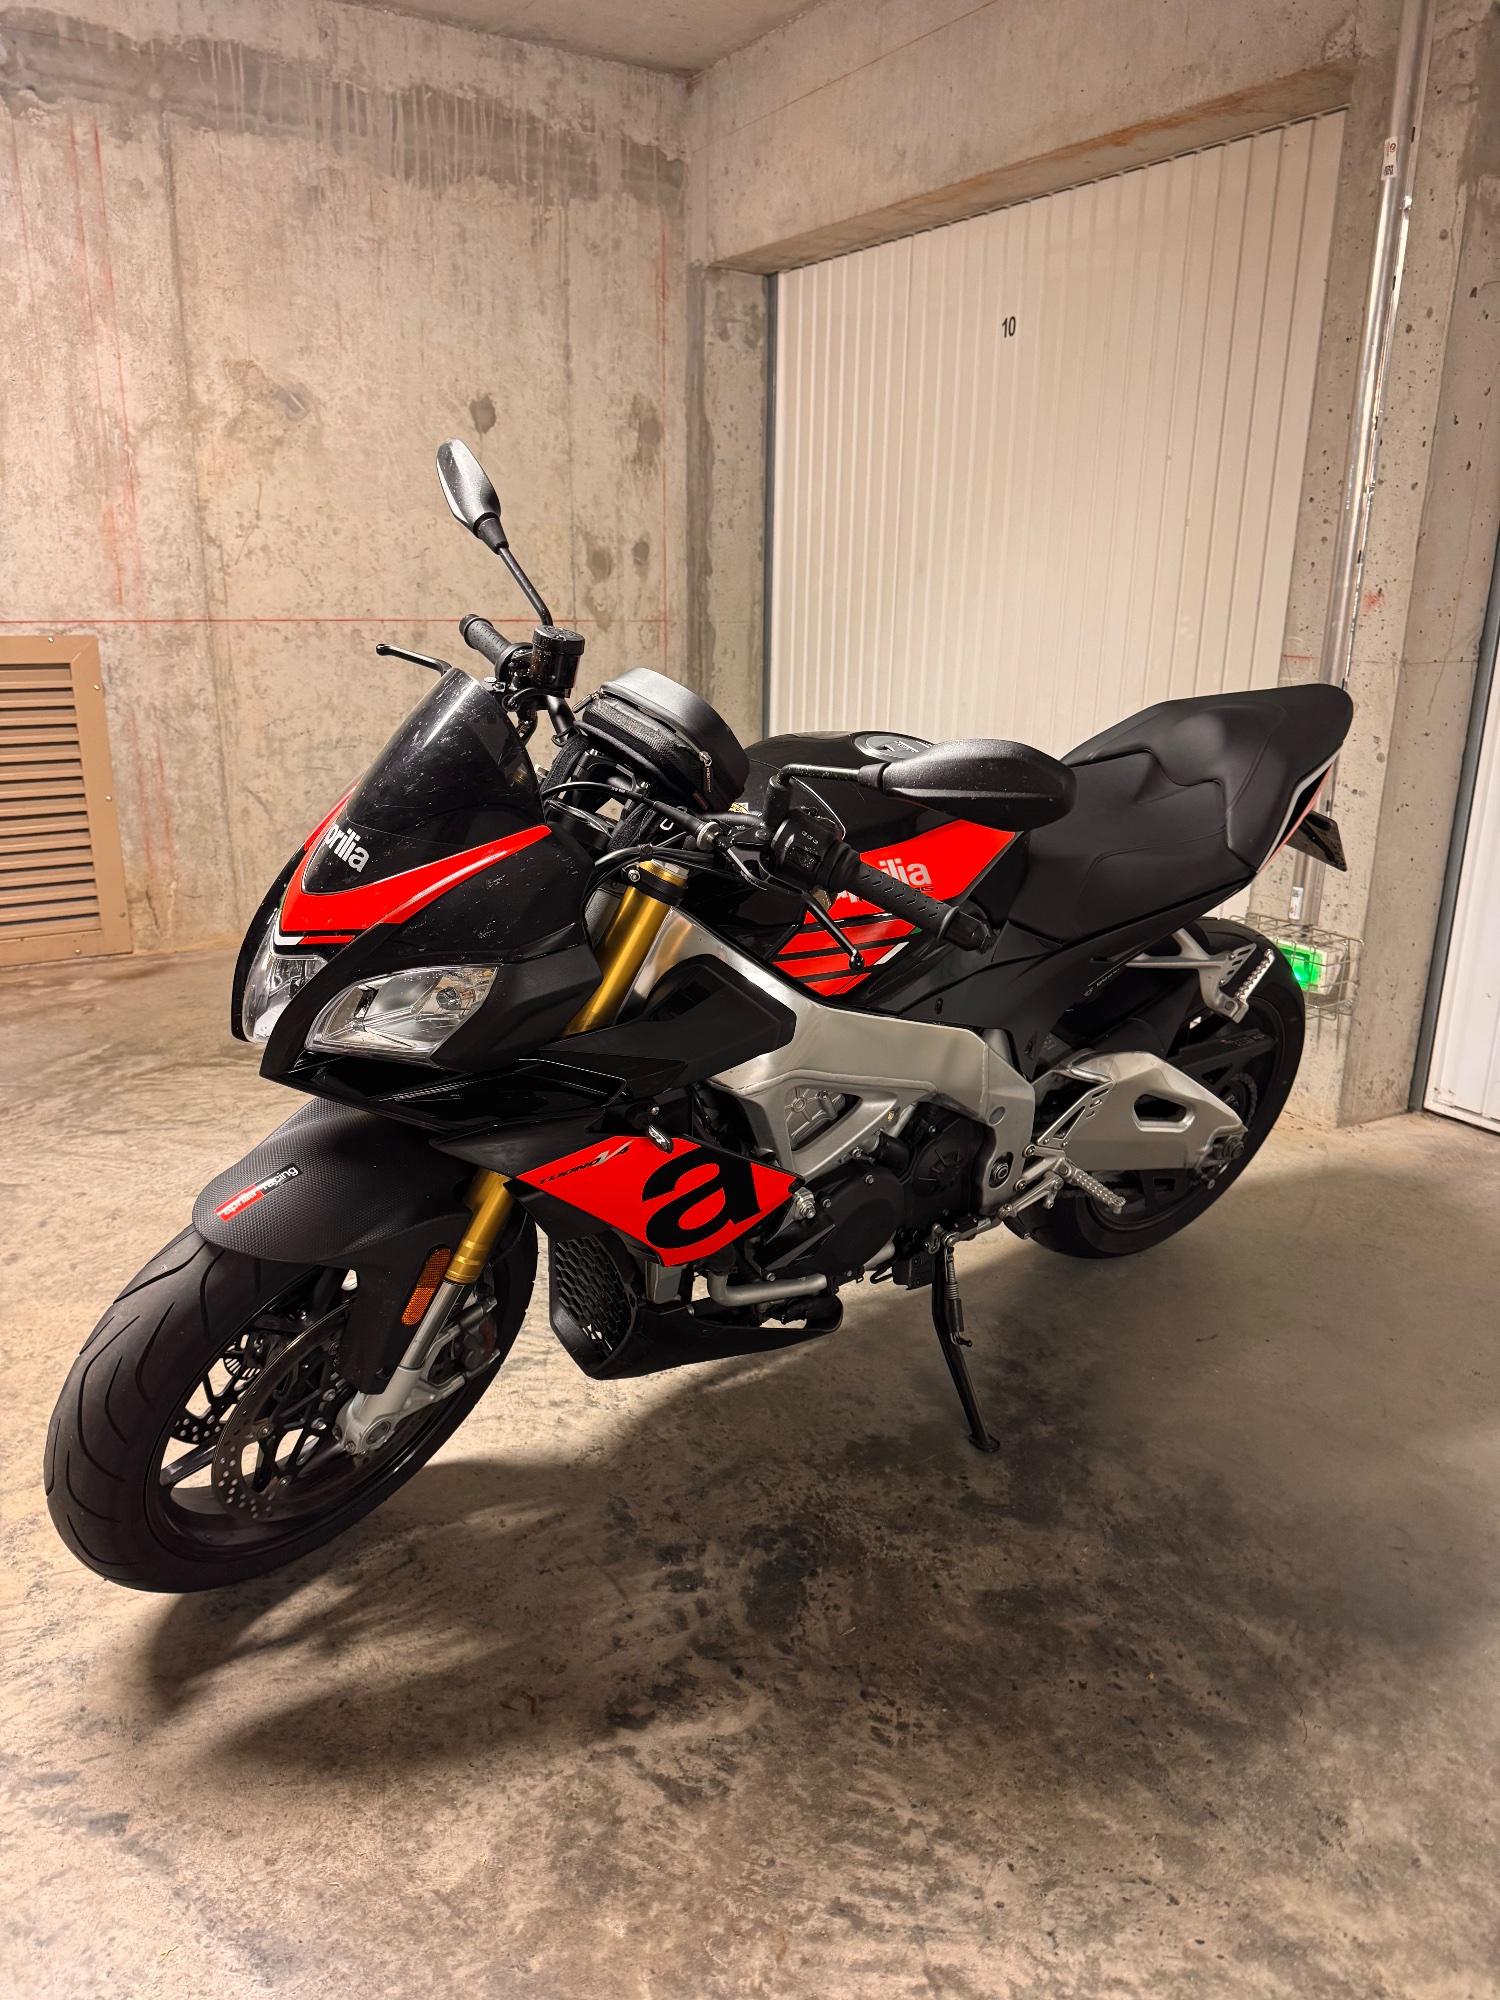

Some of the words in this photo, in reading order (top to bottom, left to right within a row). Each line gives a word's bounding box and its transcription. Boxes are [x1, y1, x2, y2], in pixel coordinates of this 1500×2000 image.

[1001, 316, 1016, 338] 10
[324, 823, 370, 873] prilia
[260, 1166, 299, 1191] racing
[641, 1147, 762, 1250] a
